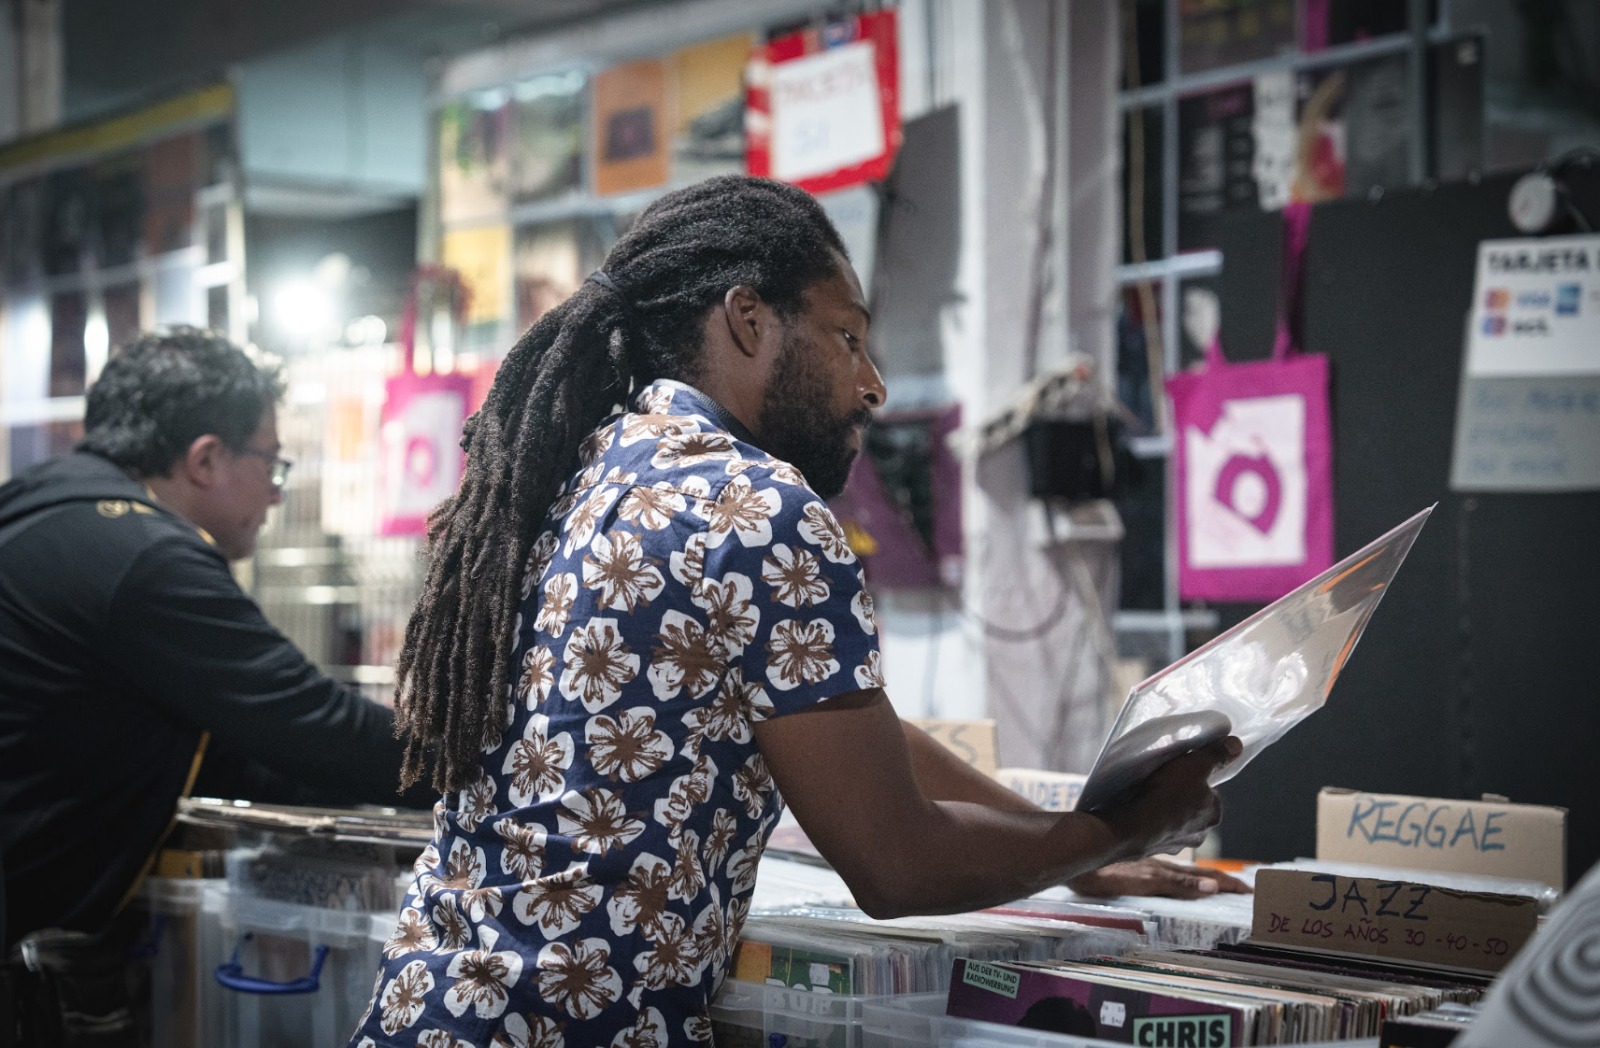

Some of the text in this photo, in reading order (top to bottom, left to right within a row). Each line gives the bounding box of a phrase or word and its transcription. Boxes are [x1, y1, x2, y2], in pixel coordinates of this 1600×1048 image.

[1347, 800, 1507, 852] REGGAE
[1309, 874, 1432, 921] JAZZ
[1267, 912, 1290, 933] DE
[1301, 918, 1333, 938] LOS
[1343, 917, 1388, 944] AÑOS
[1404, 928, 1425, 946] 30
[1446, 932, 1467, 951] 40
[1483, 937, 1508, 955] 50
[965, 971, 1016, 995] RADIOWERBUNG
[968, 962, 980, 972] AUS
[980, 965, 992, 977] DER
[1003, 972, 1018, 984] UND
[1138, 1019, 1226, 1048] CHRIS
